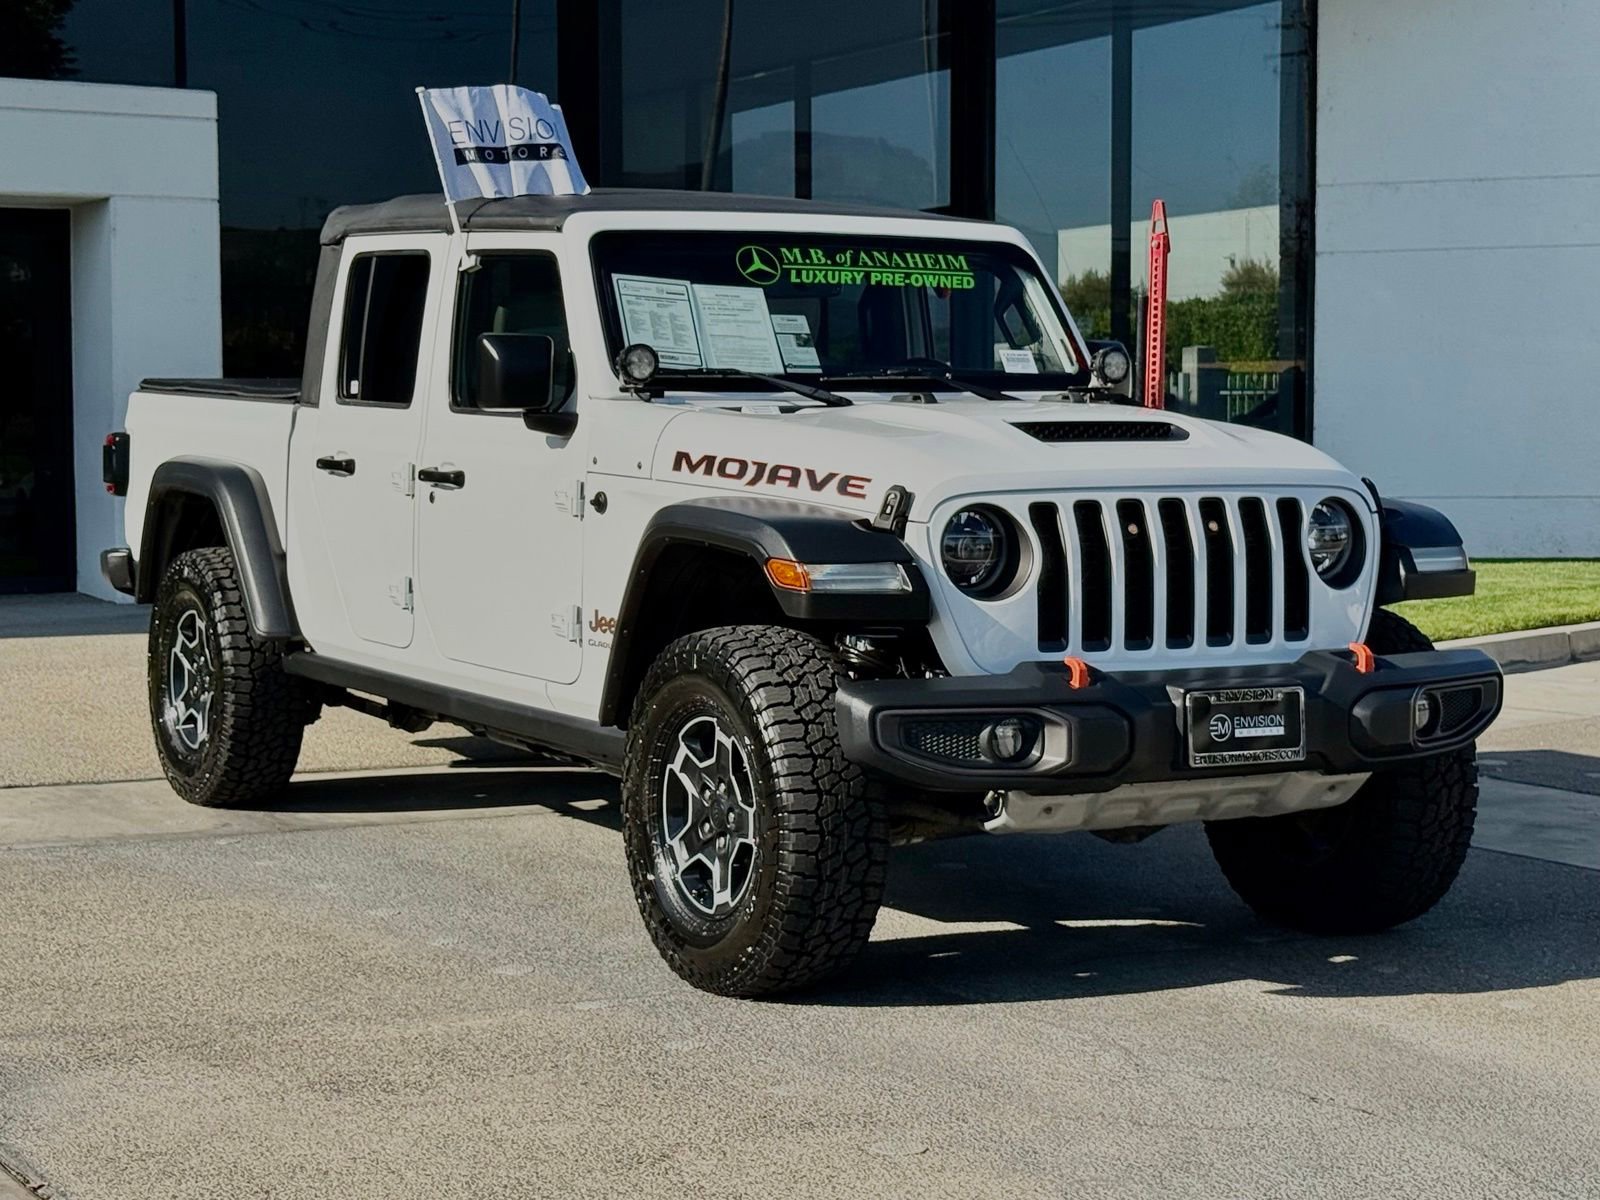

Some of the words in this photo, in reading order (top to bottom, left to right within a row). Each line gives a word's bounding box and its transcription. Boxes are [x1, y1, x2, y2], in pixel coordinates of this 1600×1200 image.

[780, 247, 832, 265] M.B.
[835, 249, 854, 268] of
[858, 250, 970, 271] ANAHEIM
[790, 269, 865, 286] LUXURY
[870, 271, 975, 290] PRE-OWNED
[671, 450, 873, 500] MOJAVE
[588, 608, 616, 635] Jee
[1219, 688, 1275, 701] ENVISION
[1233, 714, 1285, 729] ENVISION
